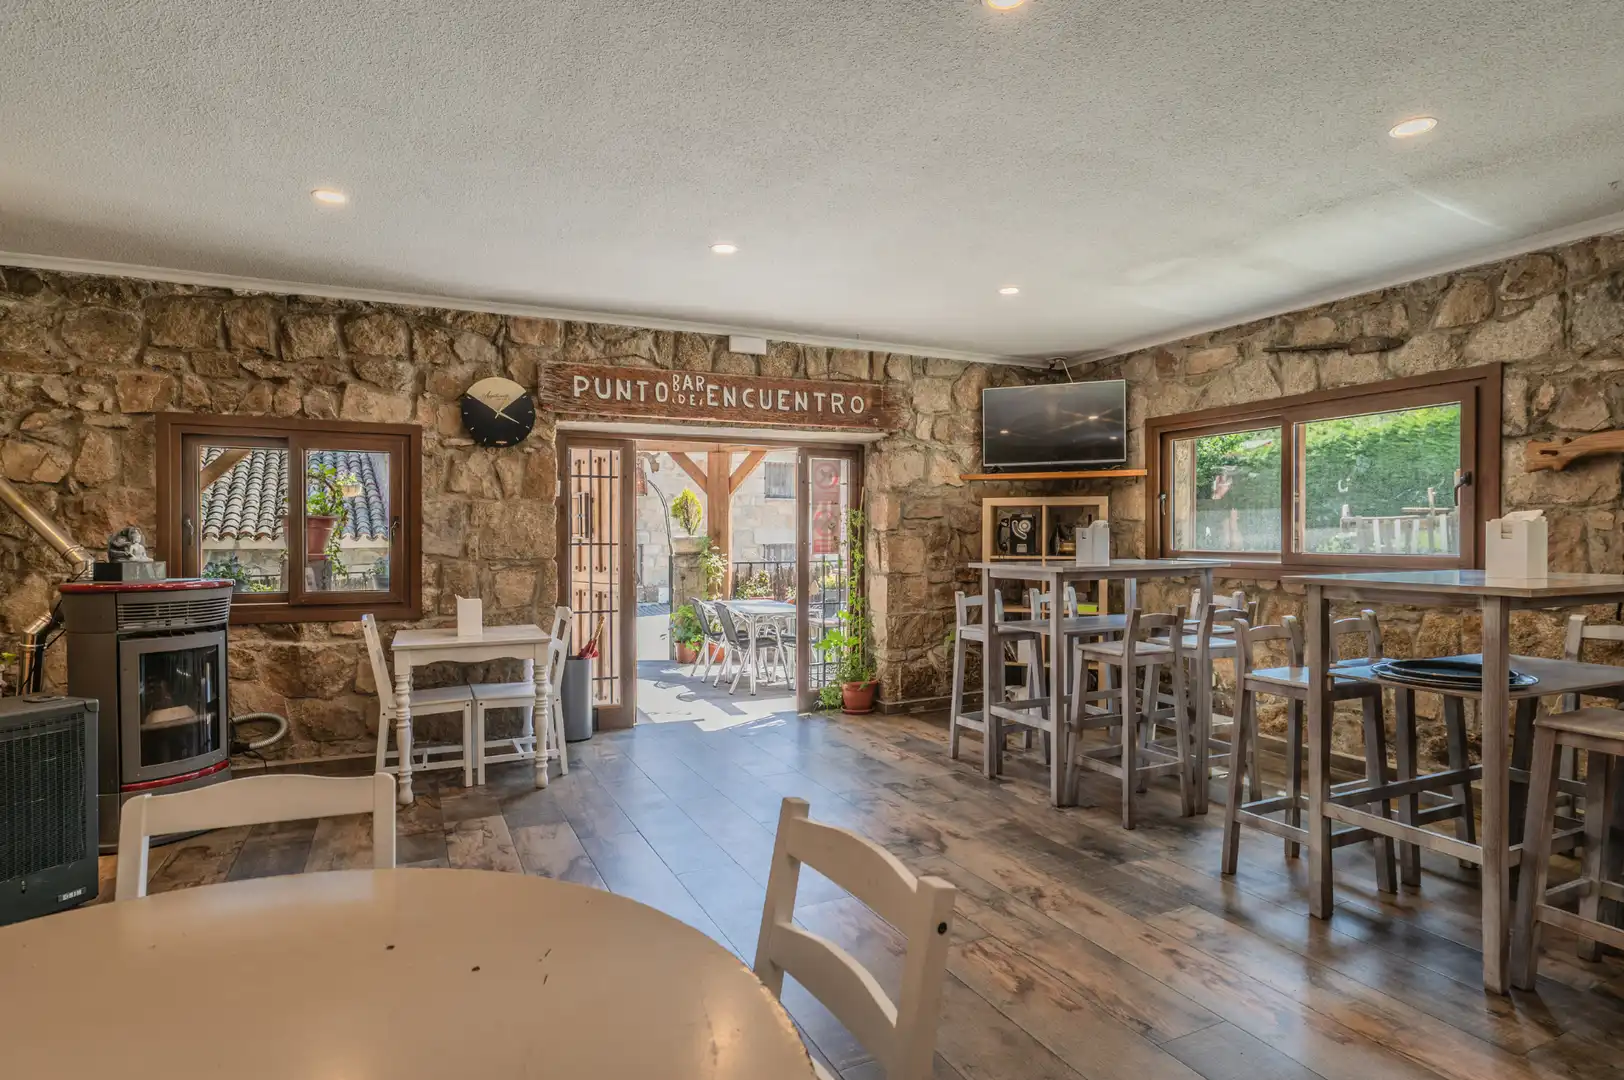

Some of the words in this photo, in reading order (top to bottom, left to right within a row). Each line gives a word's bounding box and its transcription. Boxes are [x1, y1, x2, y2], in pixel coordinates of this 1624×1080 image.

[573, 375, 668, 402] PUNTO
[706, 384, 865, 414] ENCUENTRO
[672, 374, 705, 392] BAR
